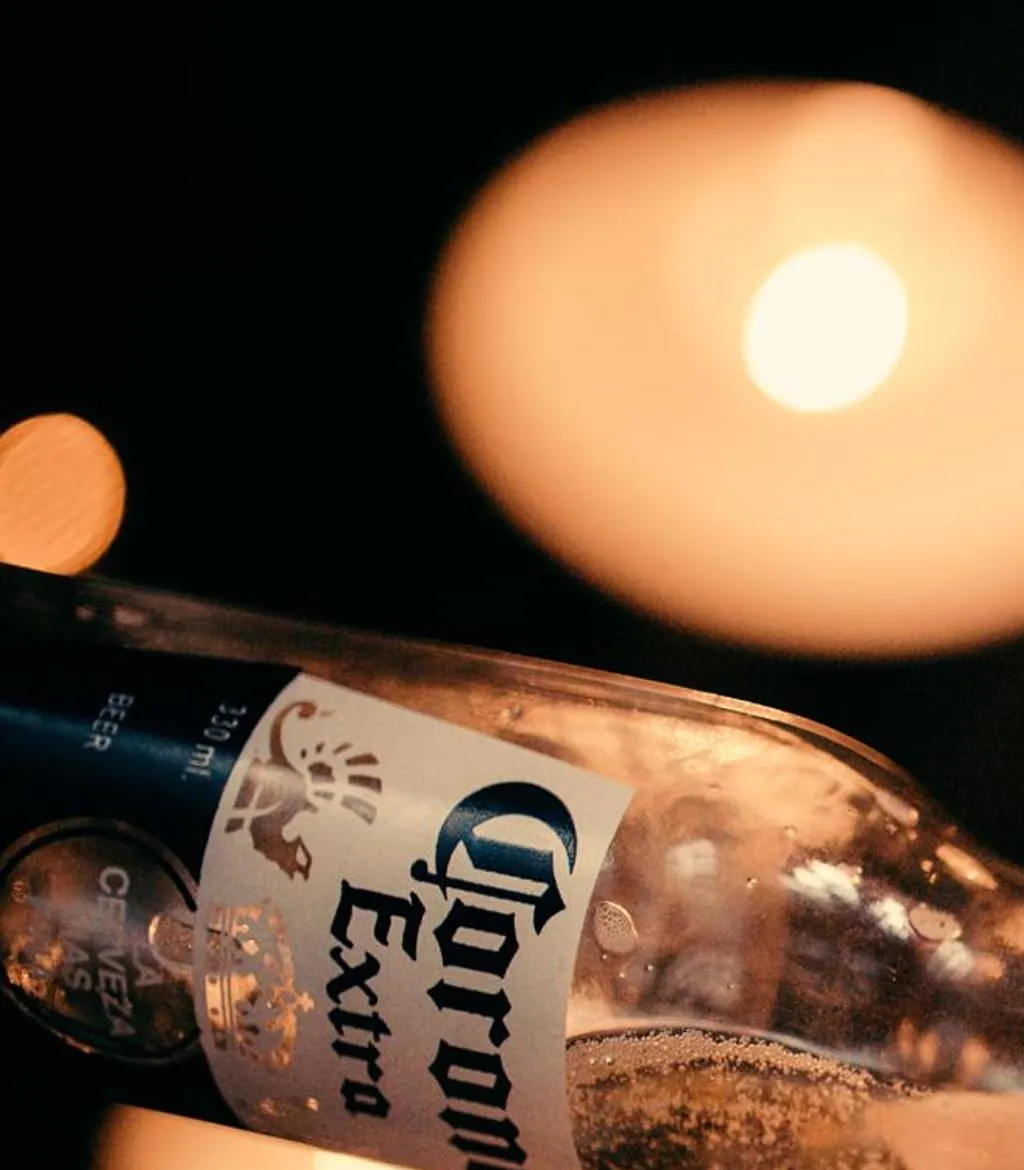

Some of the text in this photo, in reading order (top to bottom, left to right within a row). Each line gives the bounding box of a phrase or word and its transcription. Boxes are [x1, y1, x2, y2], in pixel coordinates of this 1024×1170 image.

[84, 693, 134, 751] BEER
[203, 702, 246, 742] 330
[325, 879, 426, 1119] Extra
